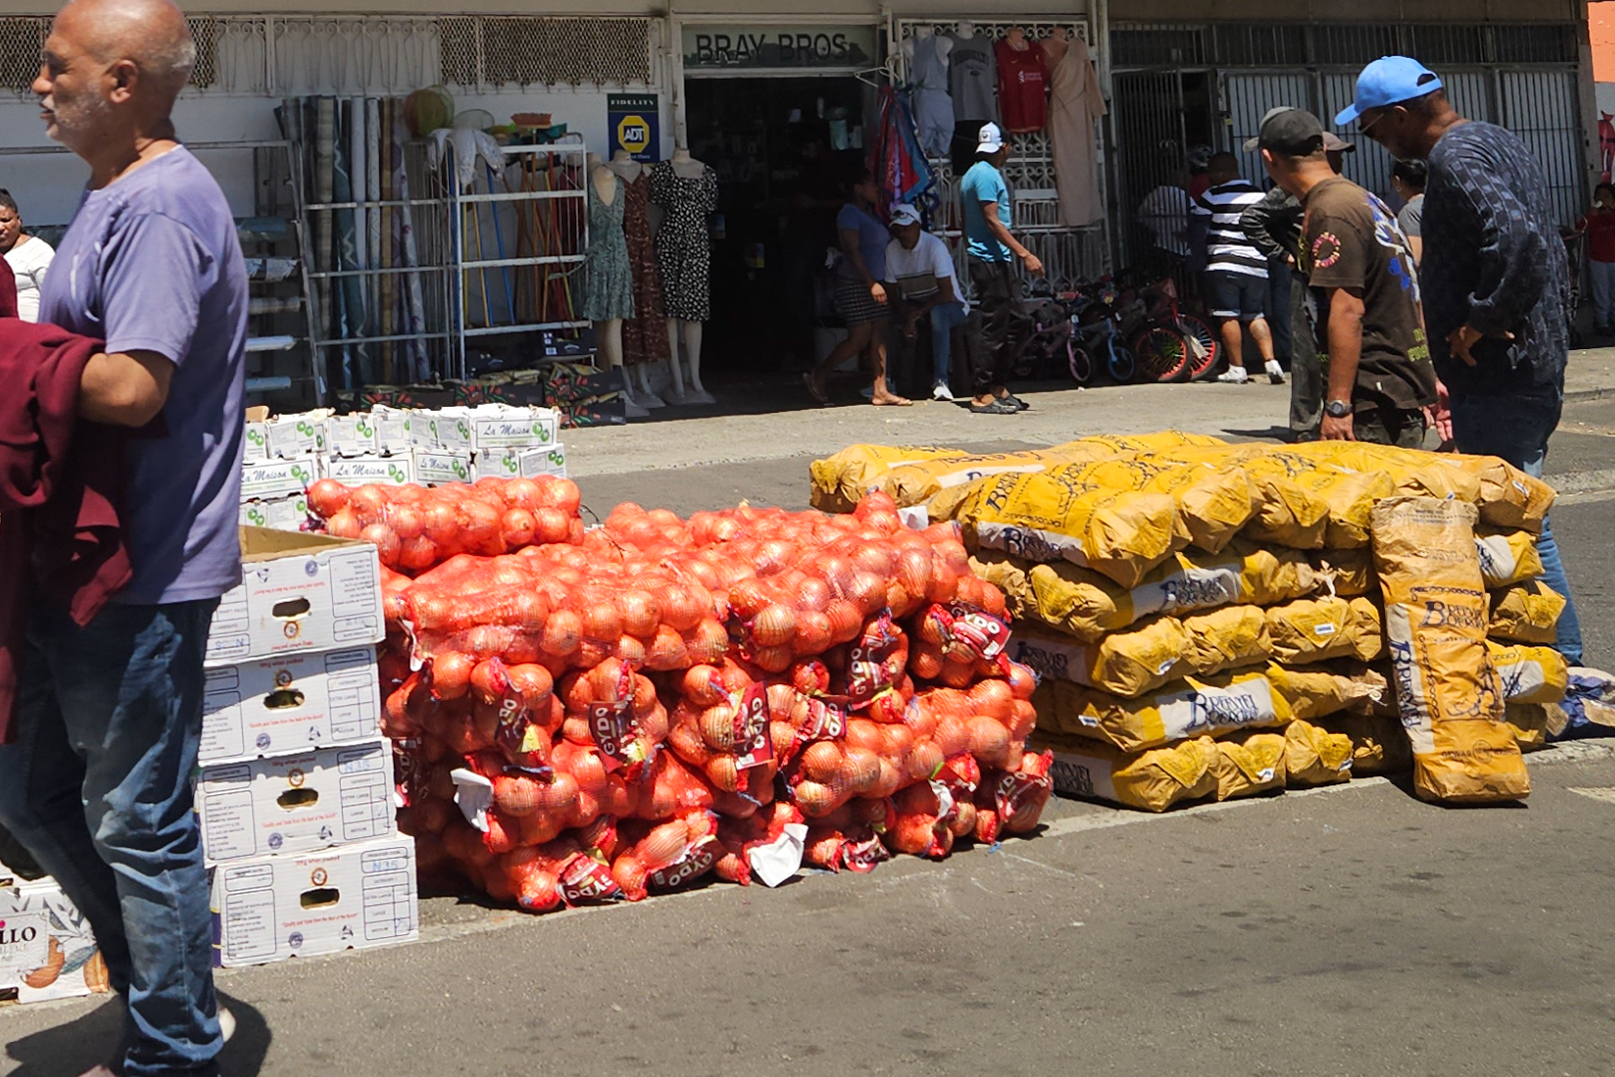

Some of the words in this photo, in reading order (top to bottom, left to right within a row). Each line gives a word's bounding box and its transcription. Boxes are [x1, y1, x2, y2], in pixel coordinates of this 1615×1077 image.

[696, 34, 766, 61] BRAY
[778, 33, 849, 60] BROS
[624, 127, 644, 141] ADT
[483, 424, 496, 436] La
[500, 424, 530, 436] Maison
[253, 468, 287, 481] Maison
[336, 464, 349, 476] La
[352, 464, 385, 475] Maison
[851, 647, 867, 695] GYDO
[595, 707, 616, 756] GYDO
[751, 697, 767, 750] GYDO
[997, 771, 1027, 795] YDO
[668, 852, 714, 887] GYDO
